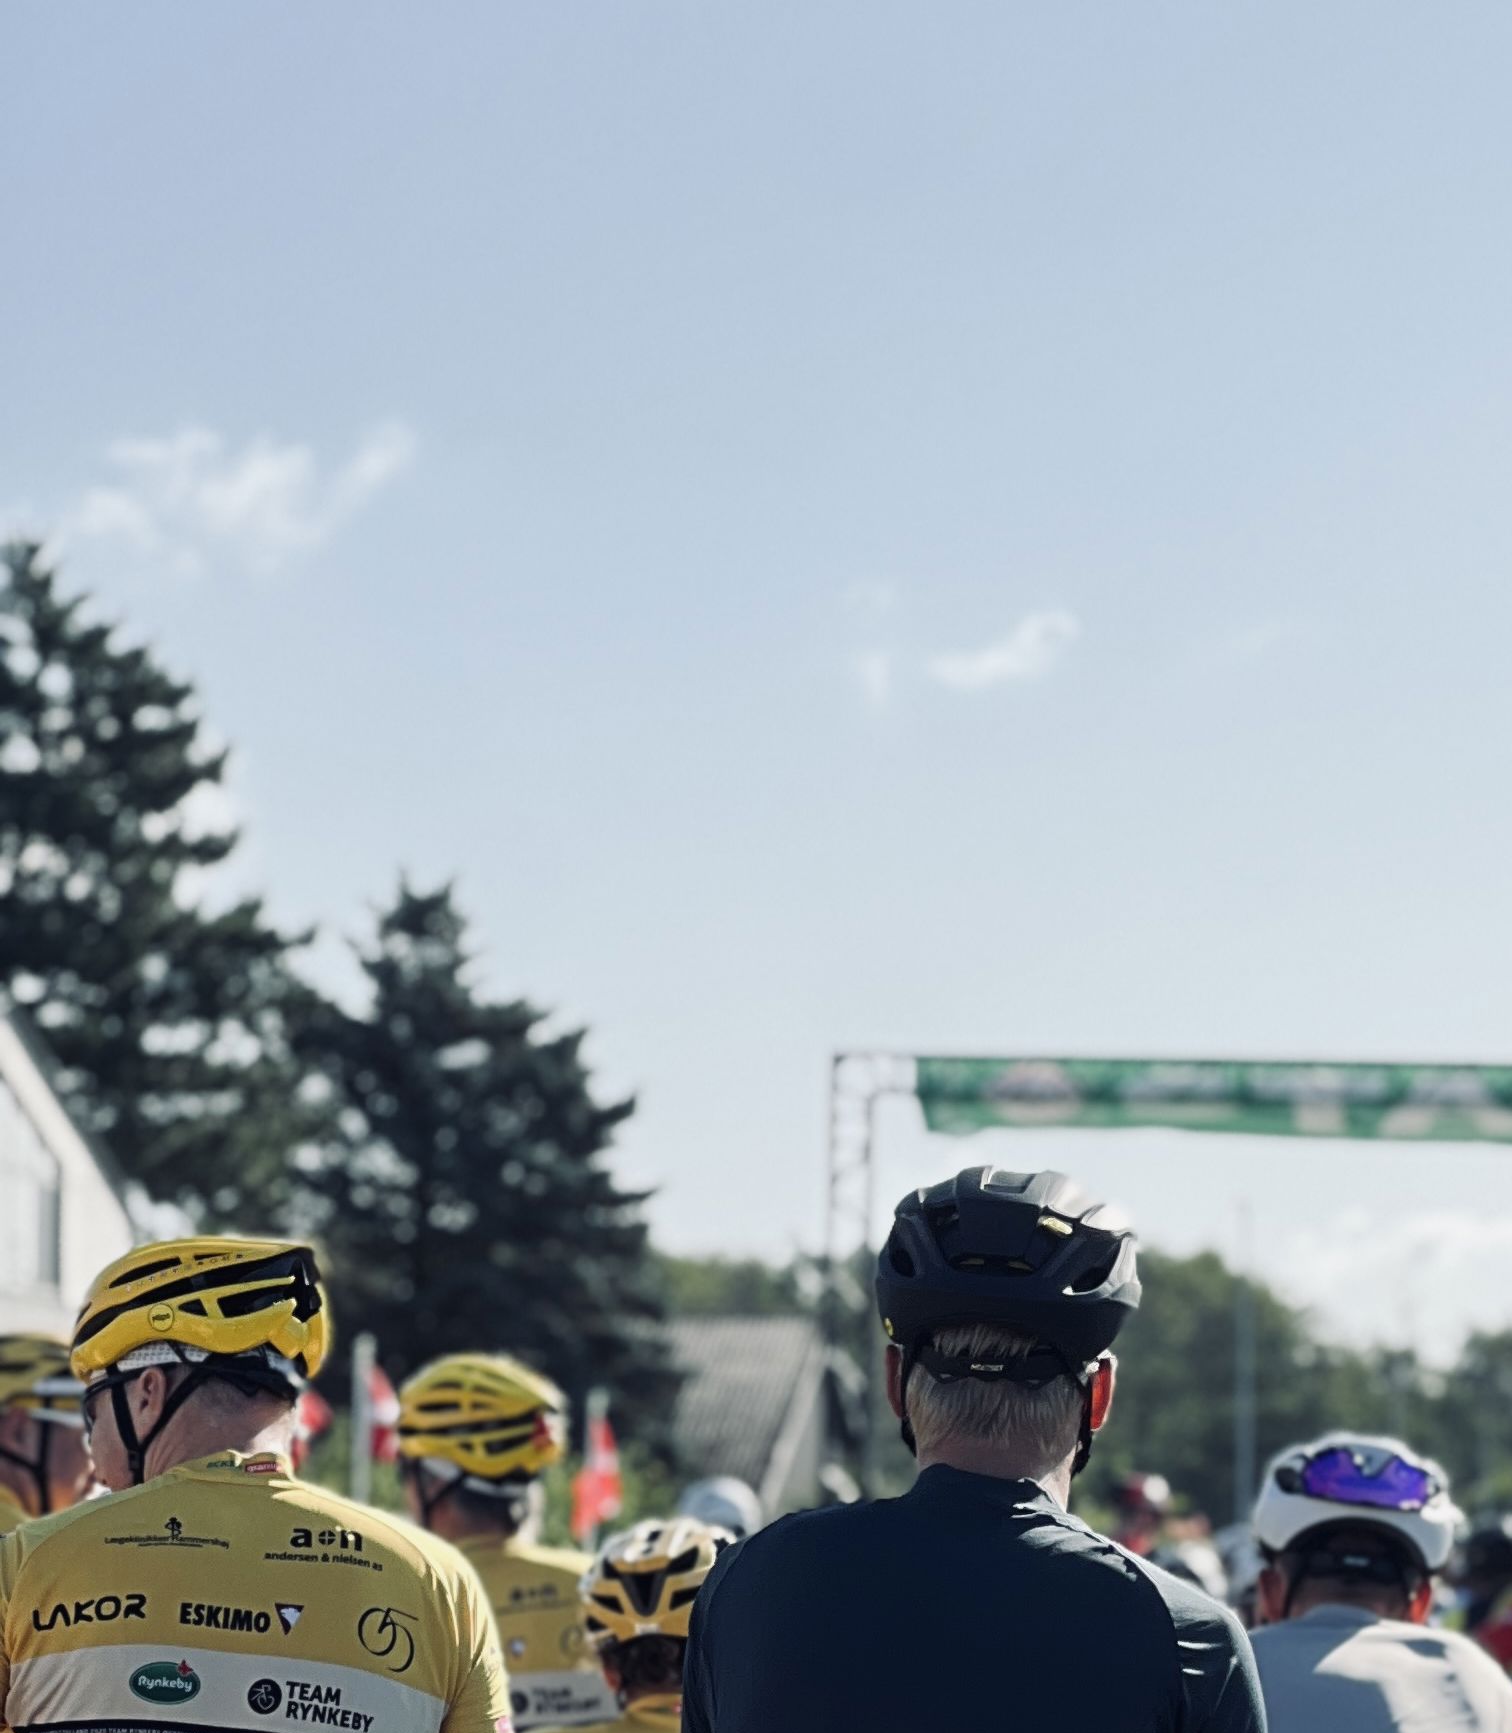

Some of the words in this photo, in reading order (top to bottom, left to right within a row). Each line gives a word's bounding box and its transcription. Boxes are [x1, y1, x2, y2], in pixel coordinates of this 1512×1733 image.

[264, 1551, 319, 1563] andersen
[321, 1553, 331, 1563] &
[332, 1554, 370, 1568] nielsen
[372, 1561, 384, 1572] as
[32, 1594, 147, 1632] LAKOR
[179, 1602, 271, 1634] ESKIMO
[137, 1675, 194, 1694] Rynkeby
[286, 1681, 342, 1706] TEAM
[285, 1701, 375, 1733] RYNKEBY
